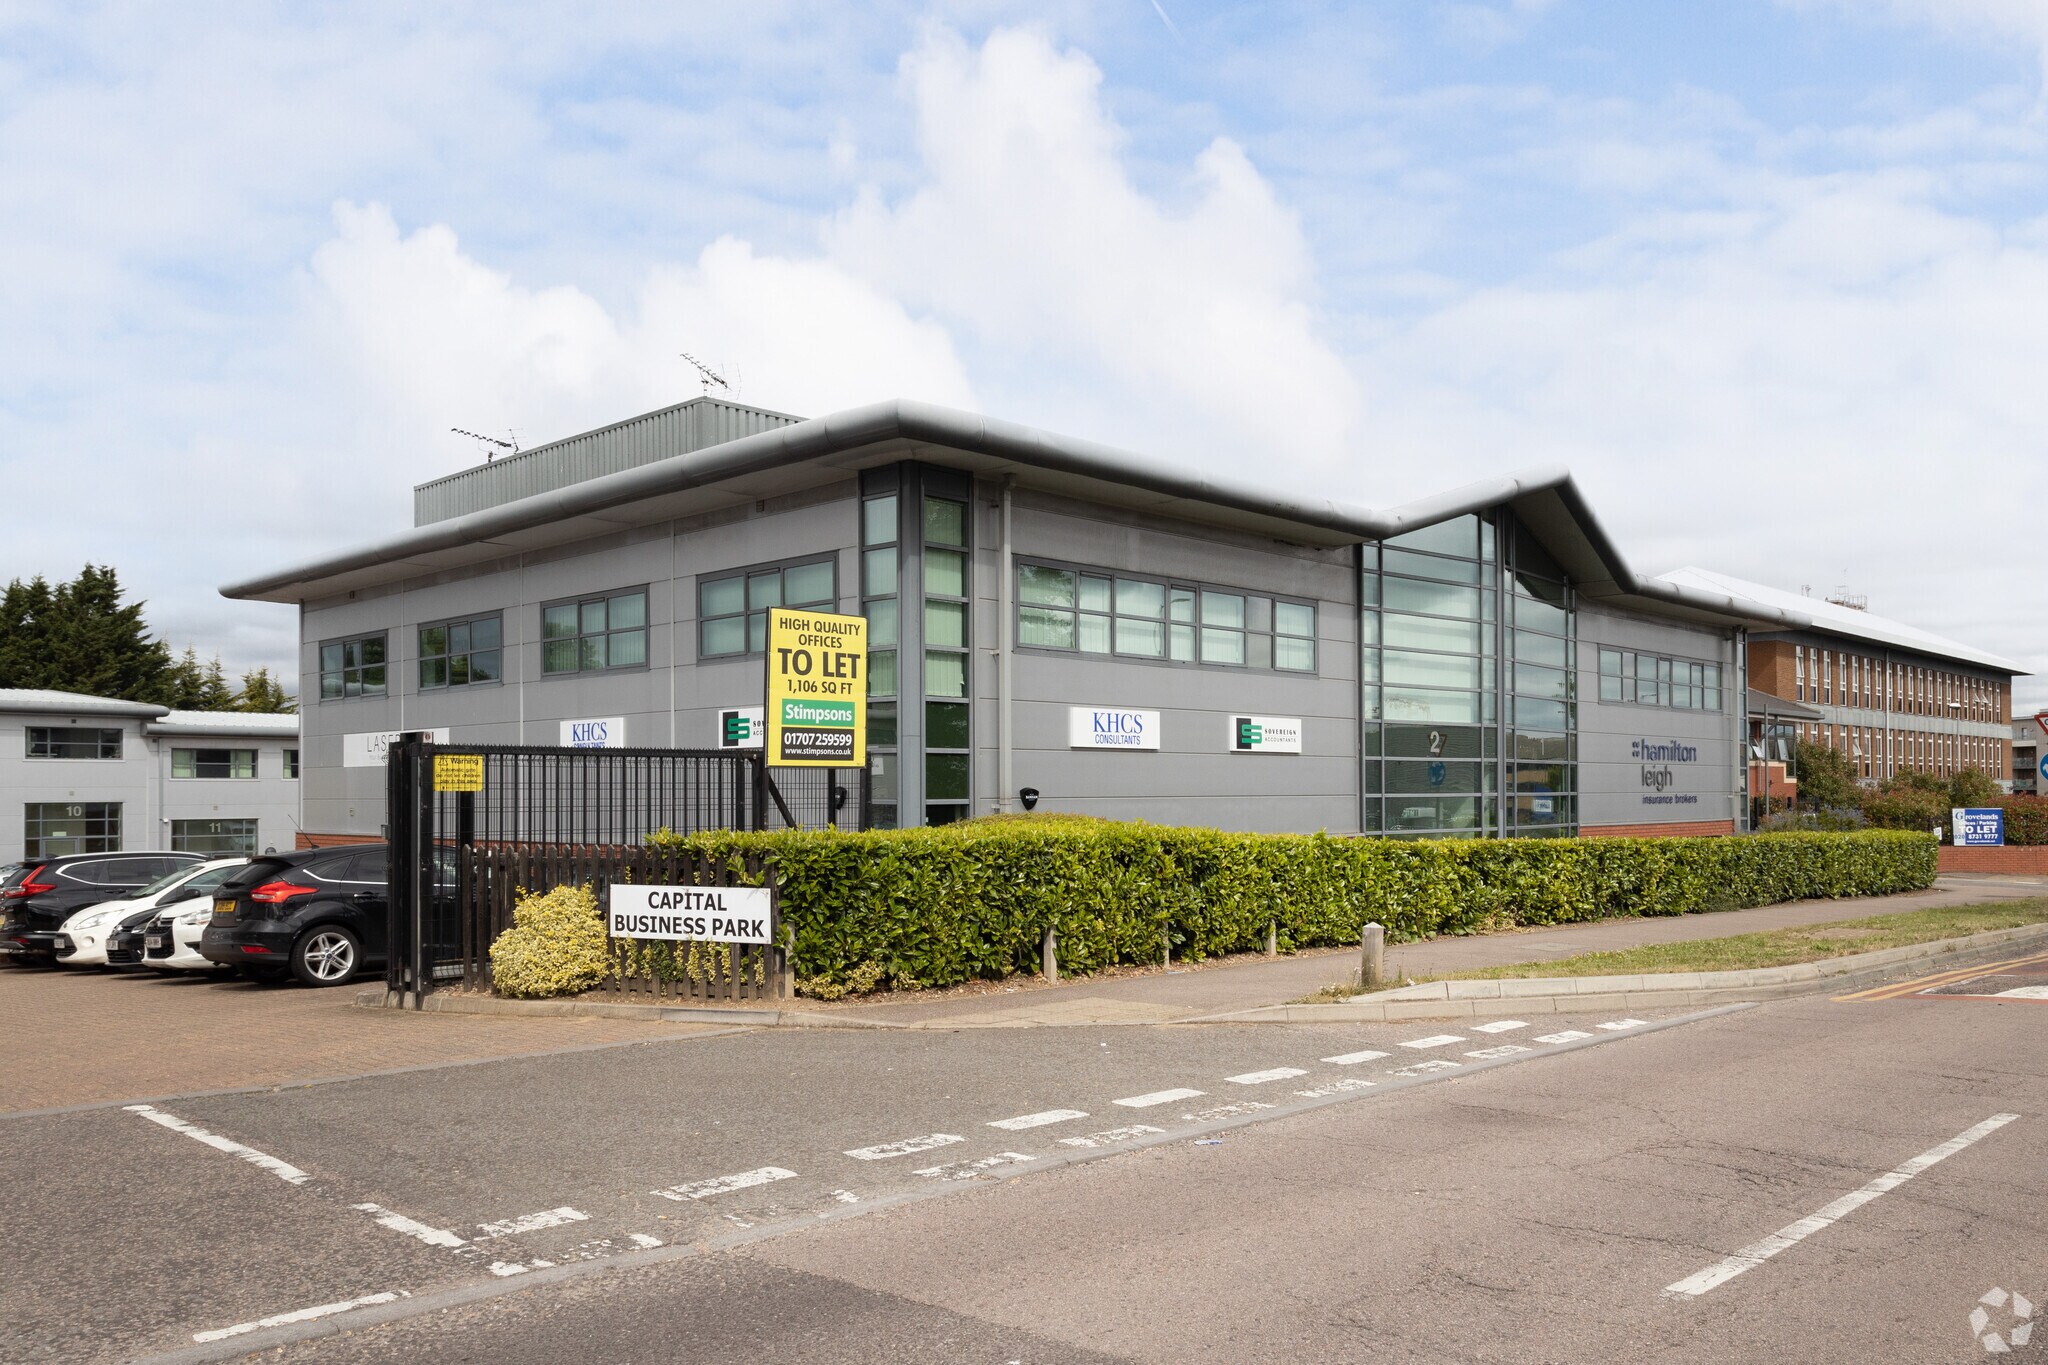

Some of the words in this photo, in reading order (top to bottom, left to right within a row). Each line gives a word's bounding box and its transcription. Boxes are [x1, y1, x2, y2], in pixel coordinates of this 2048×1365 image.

[779, 617, 810, 631] HIGH
[814, 620, 861, 636] QUALITY
[798, 633, 843, 649] OFFICES
[777, 647, 813, 676] TO
[822, 651, 861, 679] LET
[787, 679, 818, 694] 1,106
[821, 681, 837, 694] SQ
[840, 682, 853, 695] FT
[785, 703, 852, 724] Stimpsons
[572, 721, 608, 742] KHCS
[1093, 712, 1143, 734] KHCS
[1095, 734, 1141, 746] CONSULTANTS
[1264, 728, 1297, 736] SOVEREIGN
[784, 747, 852, 757] www.stimpsons.co.uk
[1641, 738, 1697, 762] hamilton
[1641, 764, 1673, 792] leigh
[1642, 794, 1673, 805] insurance
[1674, 793, 1698, 804] brokers
[65, 805, 82, 817] 10
[1955, 812, 1998, 820] Grovelands
[208, 822, 222, 833] 11
[647, 891, 728, 911] CAPITAL
[614, 914, 706, 936] BUSINESS
[712, 918, 765, 938] PARK
